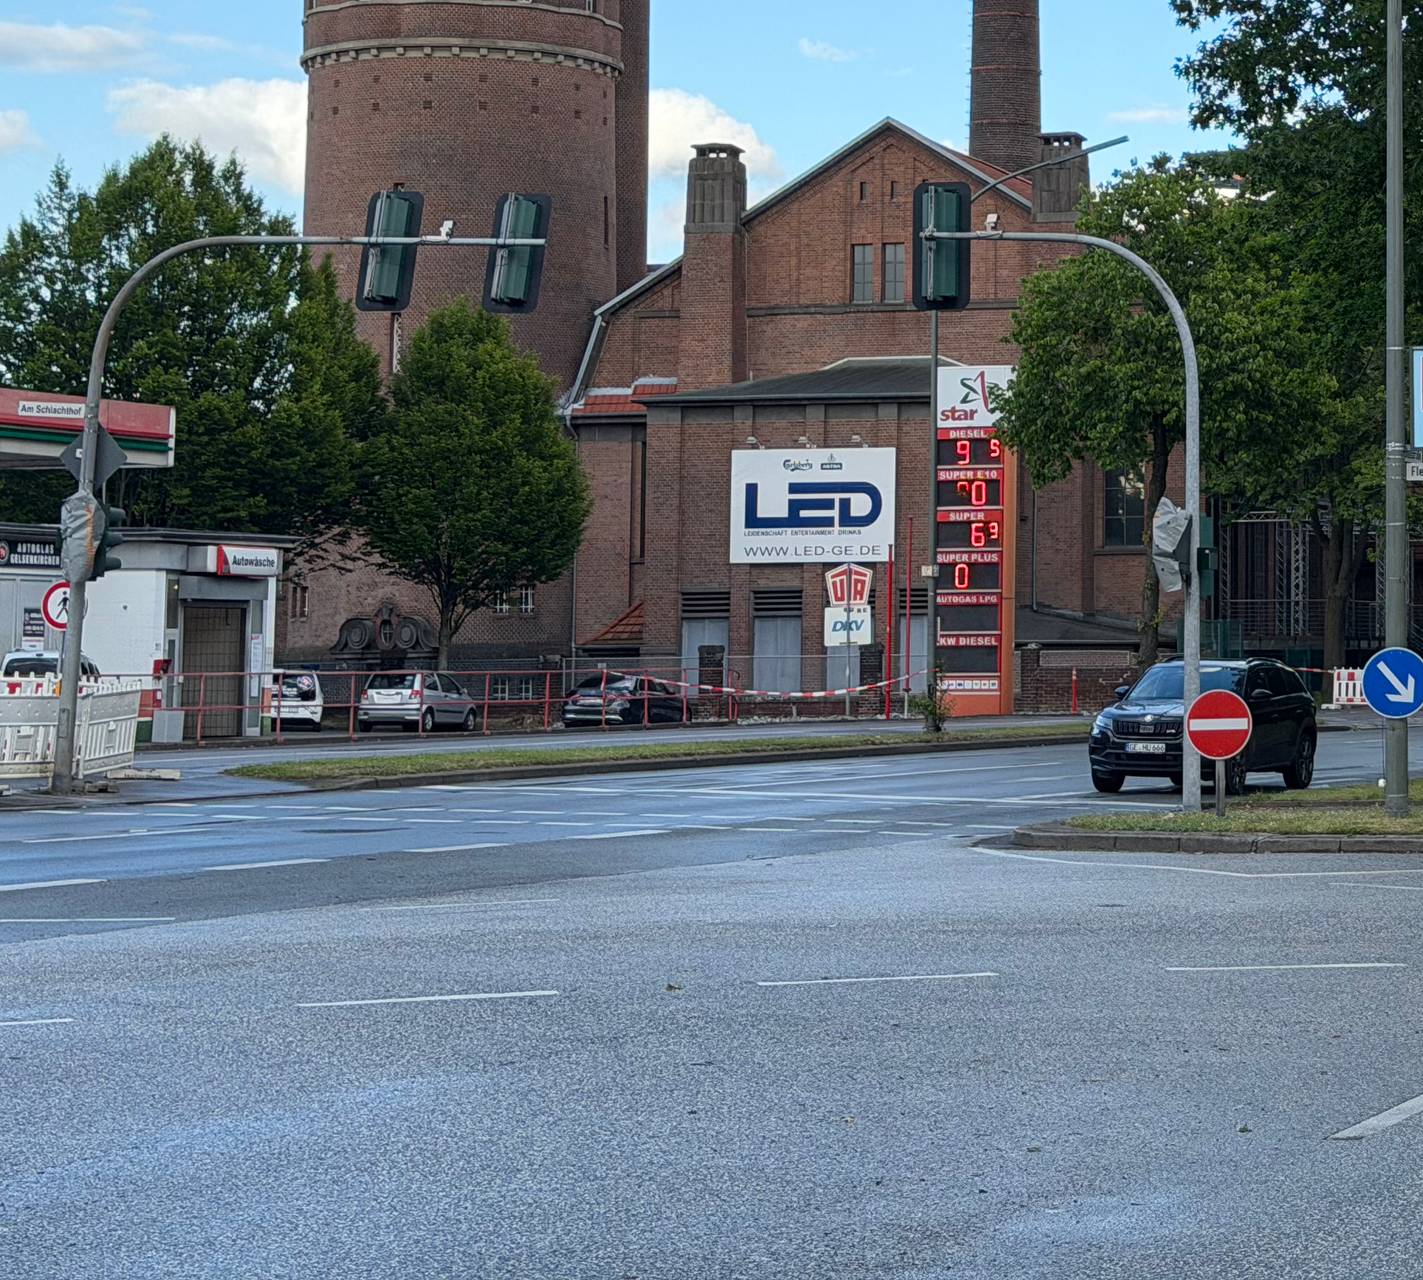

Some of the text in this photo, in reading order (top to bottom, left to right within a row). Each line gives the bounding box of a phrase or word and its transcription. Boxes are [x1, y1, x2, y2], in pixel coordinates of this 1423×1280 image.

[20, 404, 81, 416] Am Schlachthof
[940, 405, 978, 422] star
[949, 429, 988, 438] DIESEL
[940, 470, 997, 480] SUPER E10
[745, 482, 882, 529] LED
[949, 512, 985, 521] SUPER
[17, 543, 54, 554] AUTOGLAS
[744, 545, 881, 556] WWW.LED-GE.DE
[10, 554, 59, 565] GELSENKIRCHEN
[232, 555, 275, 567] Autowäsche
[937, 553, 998, 562] SUPER PLUS
[937, 594, 997, 603] AUTOGAS LPG
[832, 620, 864, 632] DKV
[960, 637, 998, 645] DIESEL
